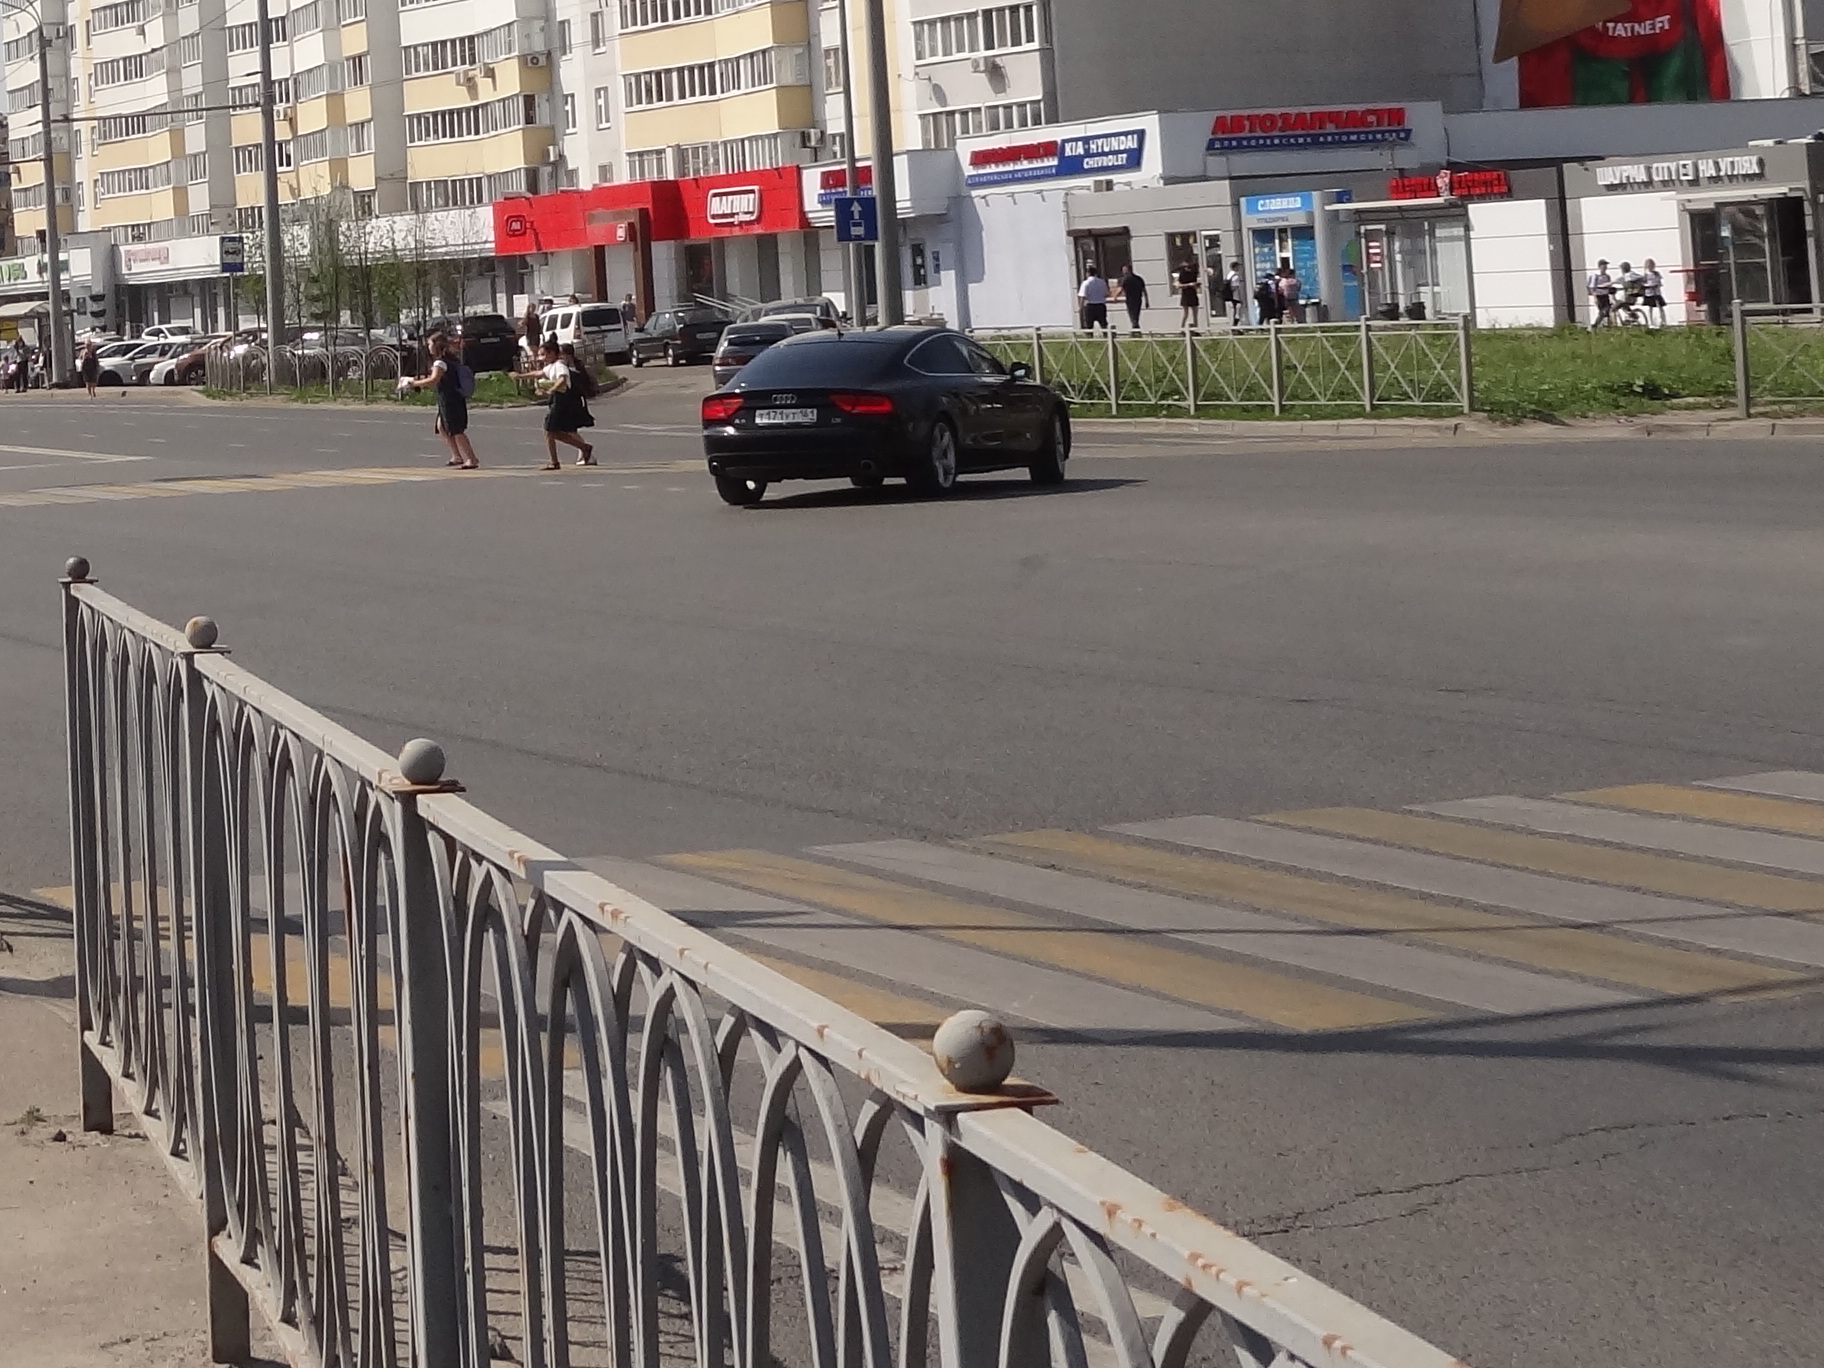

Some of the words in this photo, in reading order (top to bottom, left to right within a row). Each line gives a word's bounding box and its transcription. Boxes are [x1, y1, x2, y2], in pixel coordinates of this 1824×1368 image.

[1606, 14, 1672, 38] TATNEFT
[1211, 107, 1406, 135] АВТОЗАПЧАСТИ
[1064, 141, 1085, 157] KIA
[1089, 134, 1138, 154] HYUNDAI
[1083, 153, 1128, 170] CHEVROLET
[1697, 159, 1717, 178] НА
[711, 193, 755, 215] МАГНИТ
